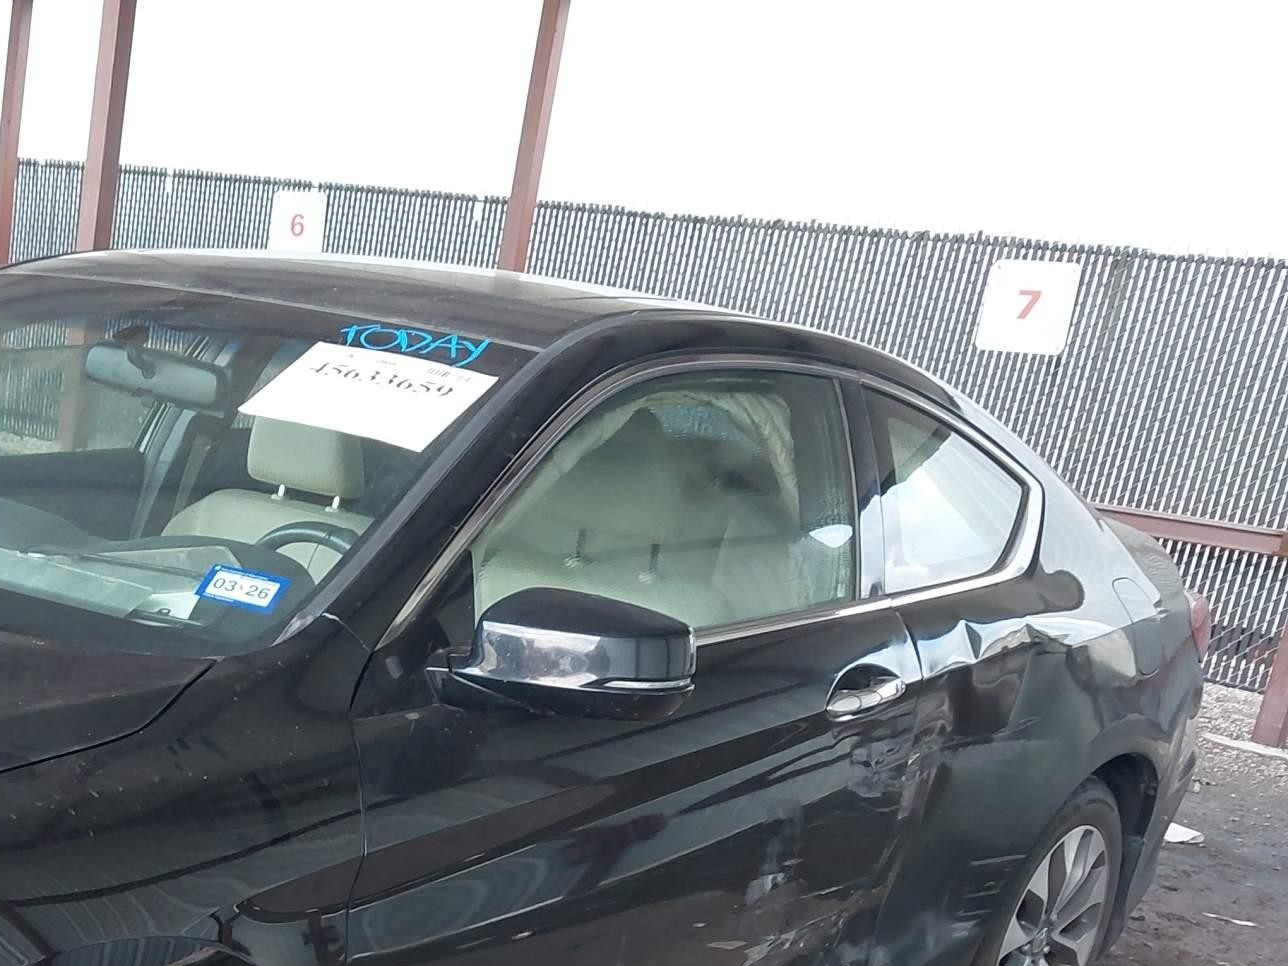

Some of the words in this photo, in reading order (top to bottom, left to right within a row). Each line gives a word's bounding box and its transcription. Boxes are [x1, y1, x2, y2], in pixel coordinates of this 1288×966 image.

[291, 213, 304, 237] 6
[1016, 289, 1042, 319] 7
[340, 324, 491, 367] TODAY
[245, 584, 271, 600] 26
